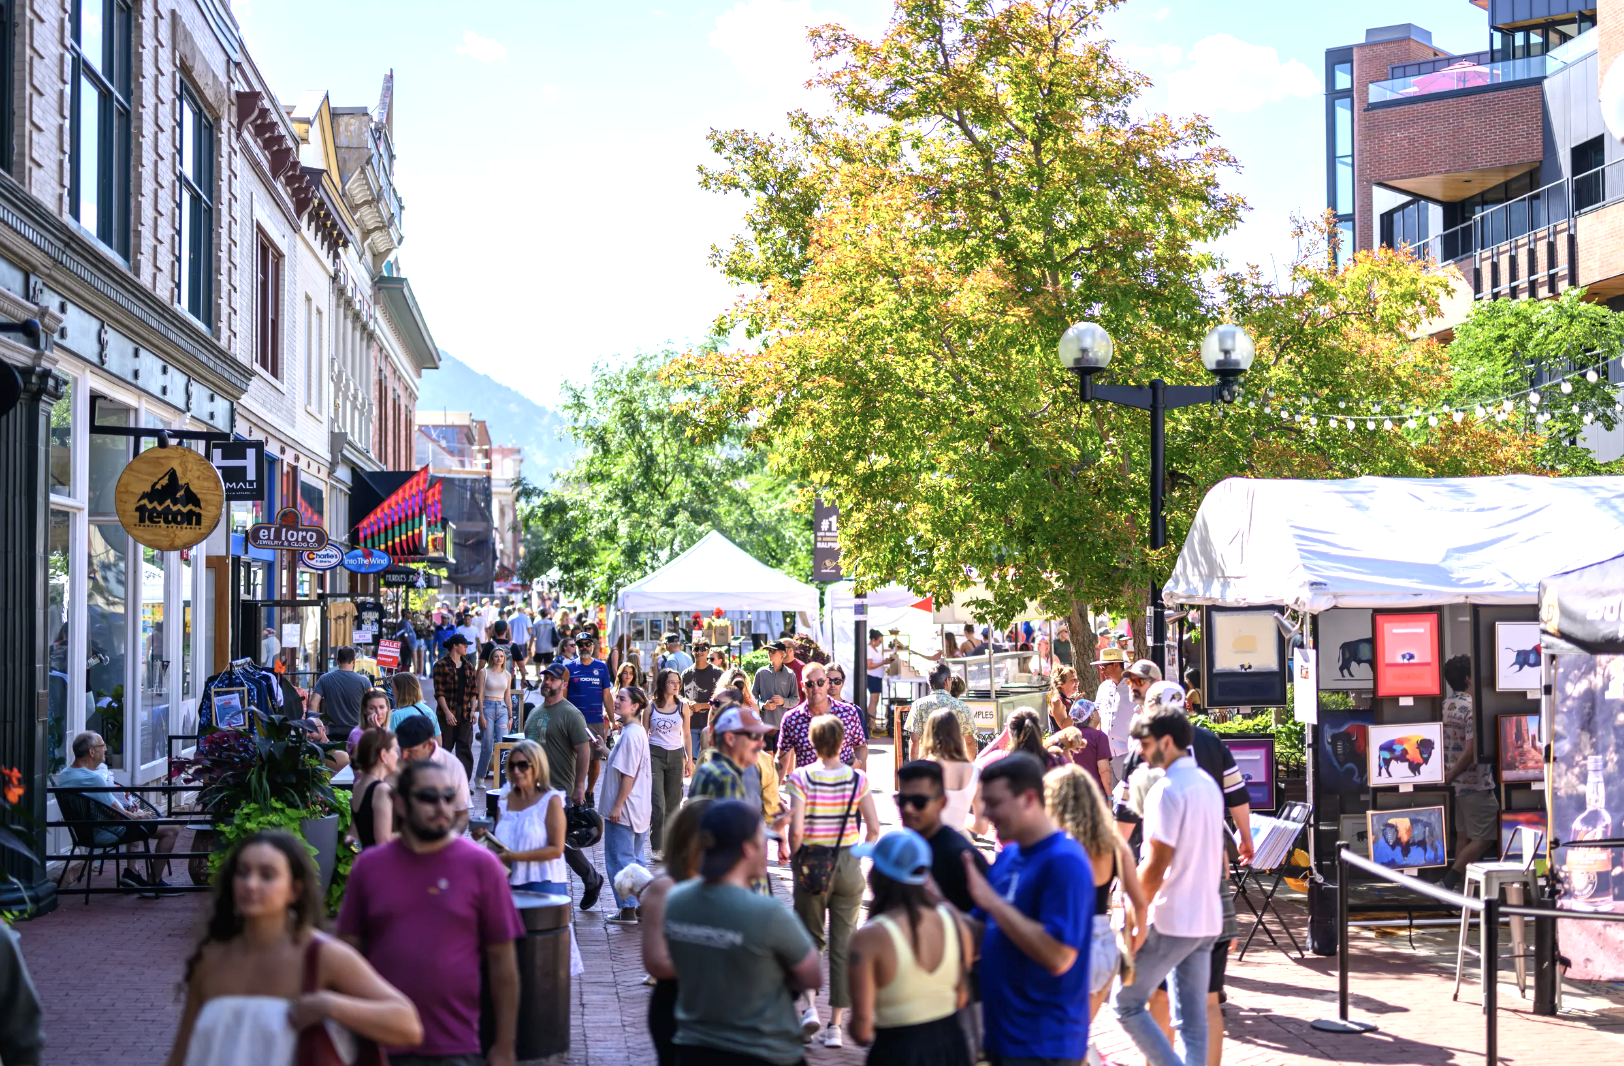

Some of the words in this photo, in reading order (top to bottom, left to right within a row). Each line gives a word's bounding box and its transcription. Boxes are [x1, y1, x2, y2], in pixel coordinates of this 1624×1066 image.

[135, 503, 203, 527] Teton
[820, 515, 838, 532] #1
[259, 528, 275, 540] el
[281, 528, 317, 543] loro
[306, 551, 338, 561] Charlie's
[344, 557, 357, 565] Into
[357, 557, 369, 565] The
[369, 557, 387, 565] Wind
[380, 640, 401, 649] SALE!
[973, 711, 994, 720] MPLES
